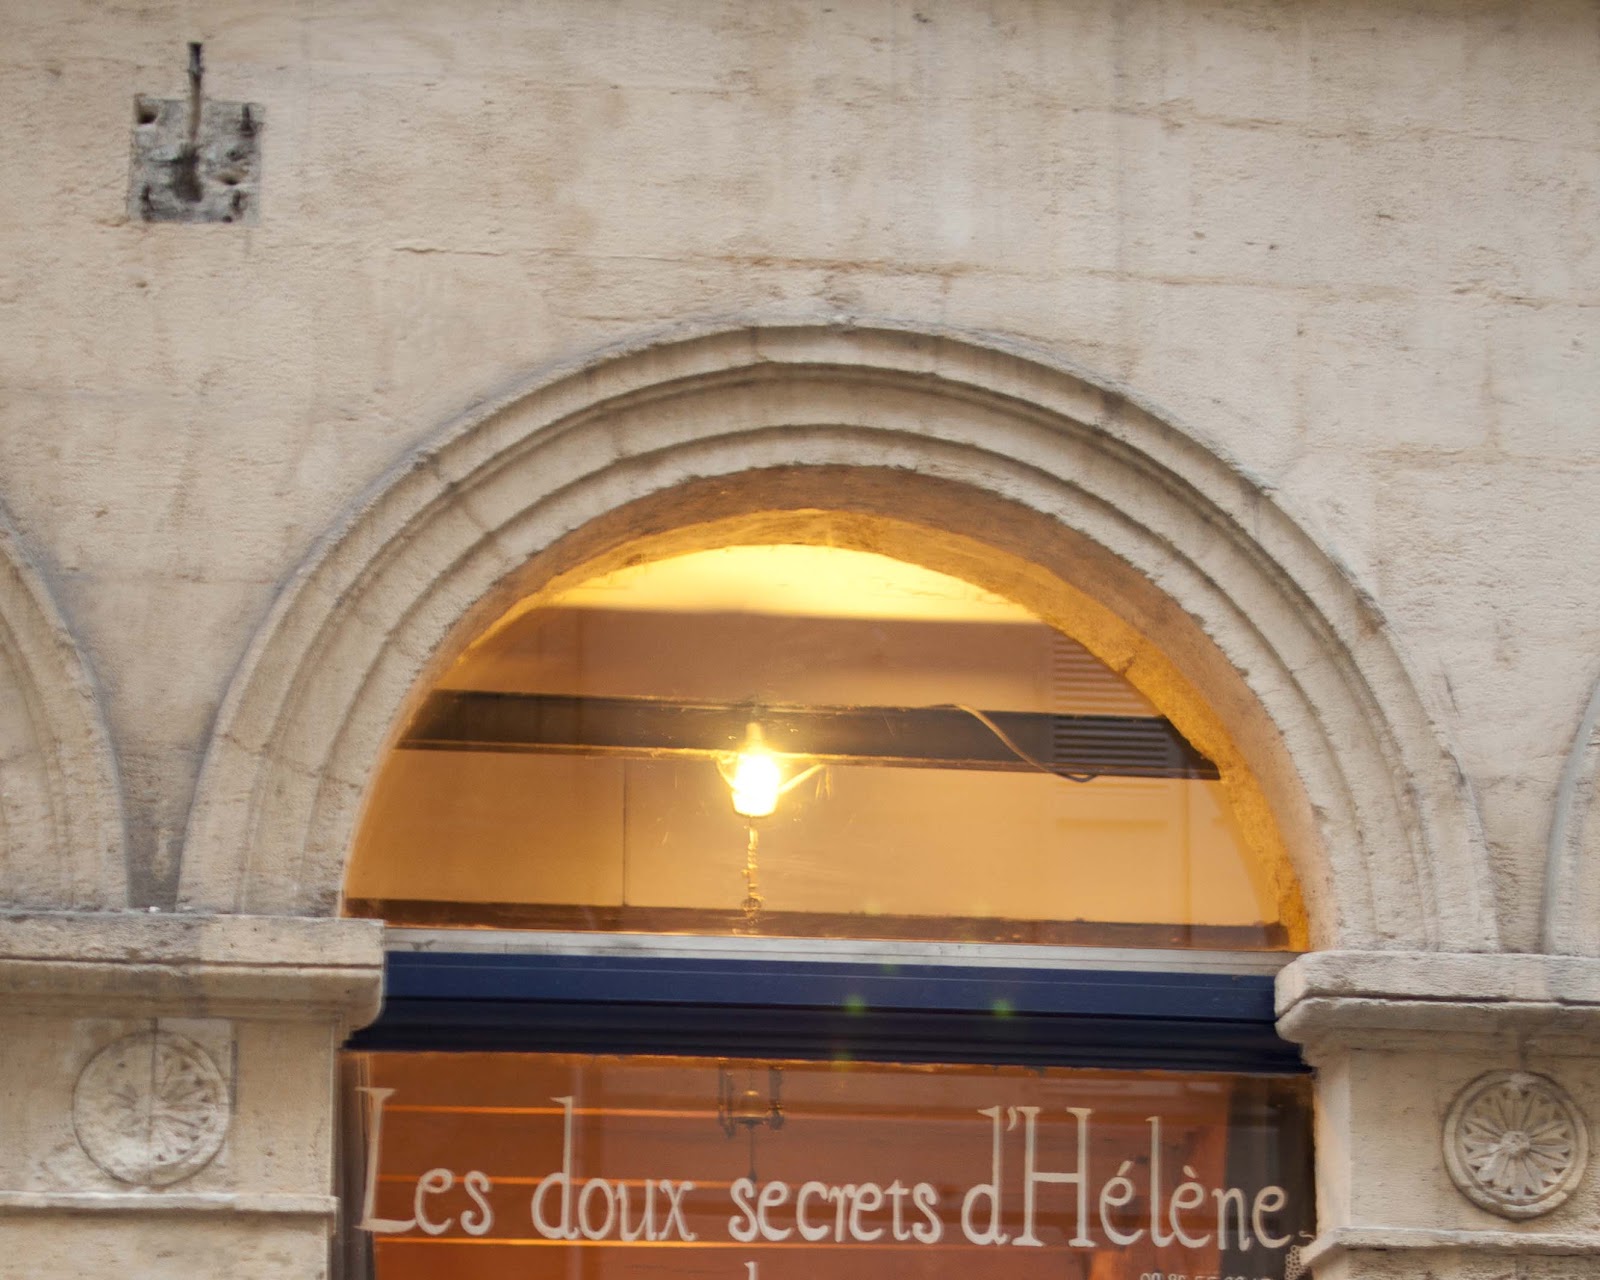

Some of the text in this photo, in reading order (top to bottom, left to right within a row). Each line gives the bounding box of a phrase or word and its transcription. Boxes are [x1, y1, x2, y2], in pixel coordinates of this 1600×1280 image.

[354, 1087, 1293, 1251] Les doux secrets d'Hélène
